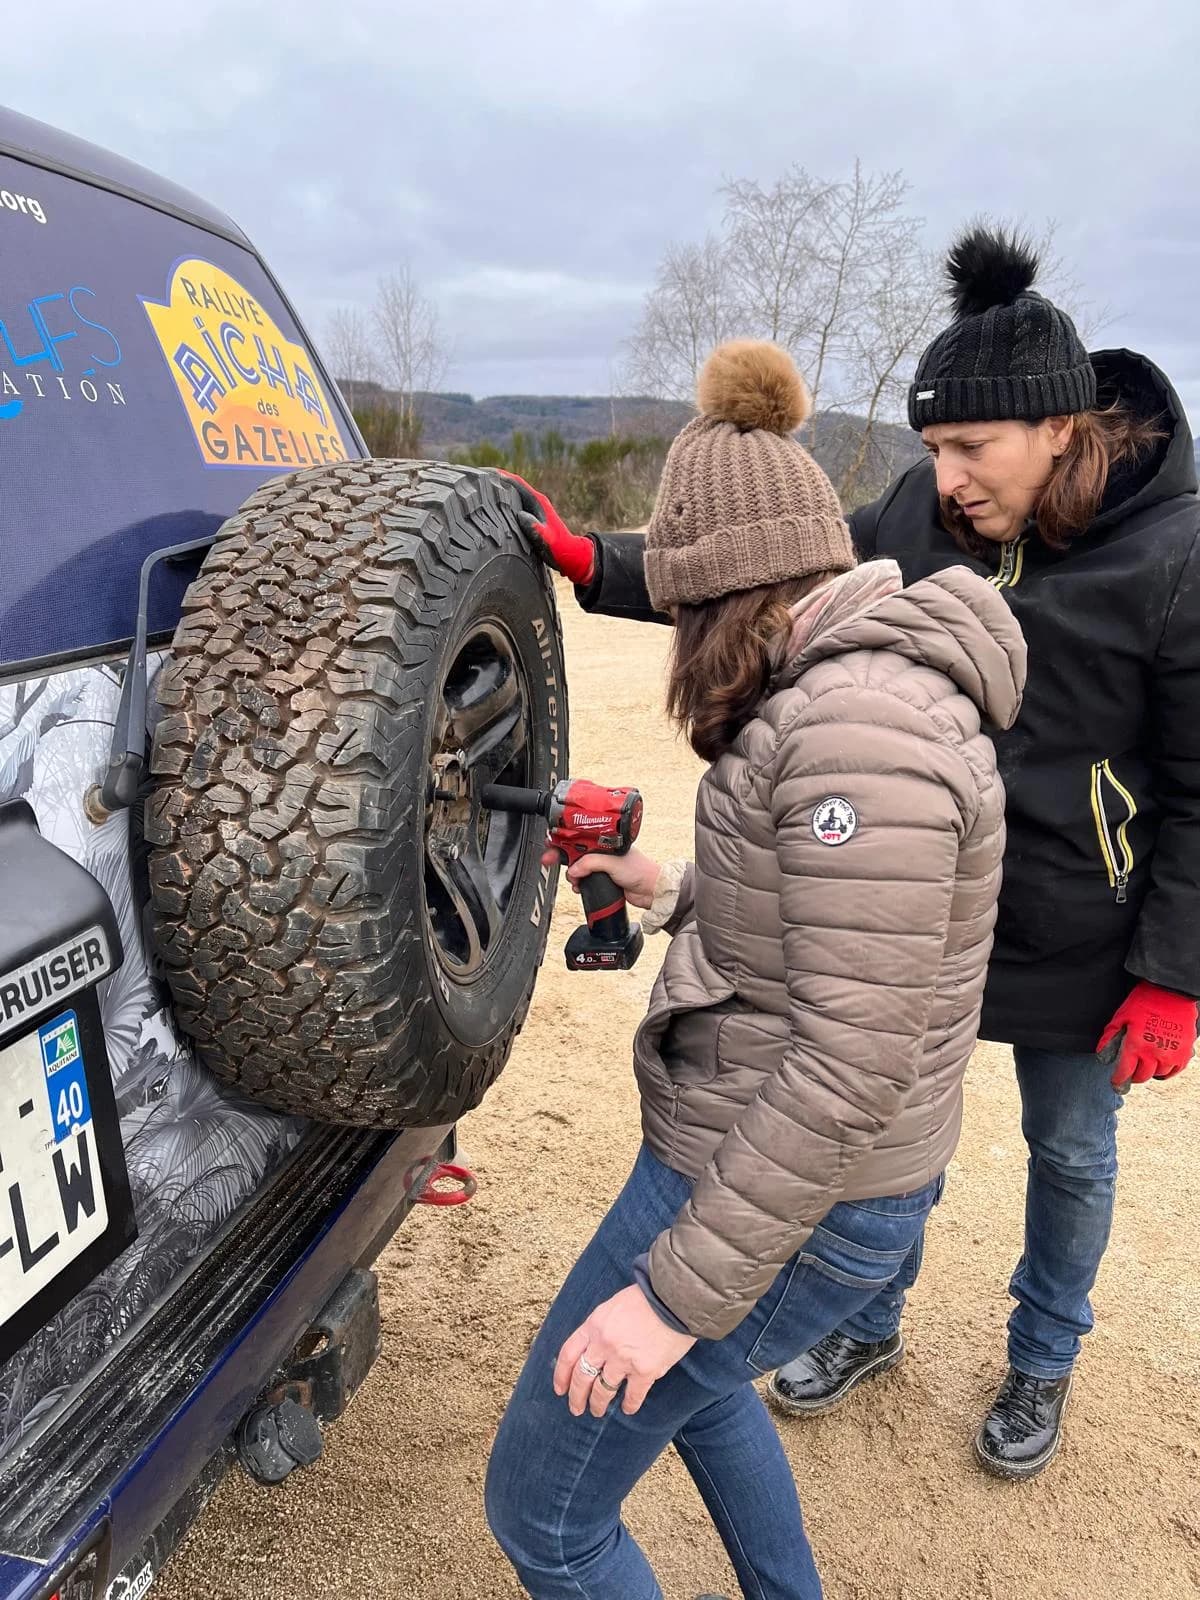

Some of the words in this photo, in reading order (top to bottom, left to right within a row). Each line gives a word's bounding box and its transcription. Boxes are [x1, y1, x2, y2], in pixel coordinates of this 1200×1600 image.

[180, 276, 264, 327] RALLYE
[257, 398, 280, 417] des
[201, 420, 345, 462] GAZELLES
[531, 618, 559, 790] All-Terra
[572, 812, 613, 825] Milwaukee
[1143, 1032, 1180, 1050] site
[47, 1050, 79, 1075] AQUITAINE
[57, 1081, 84, 1127] 40
